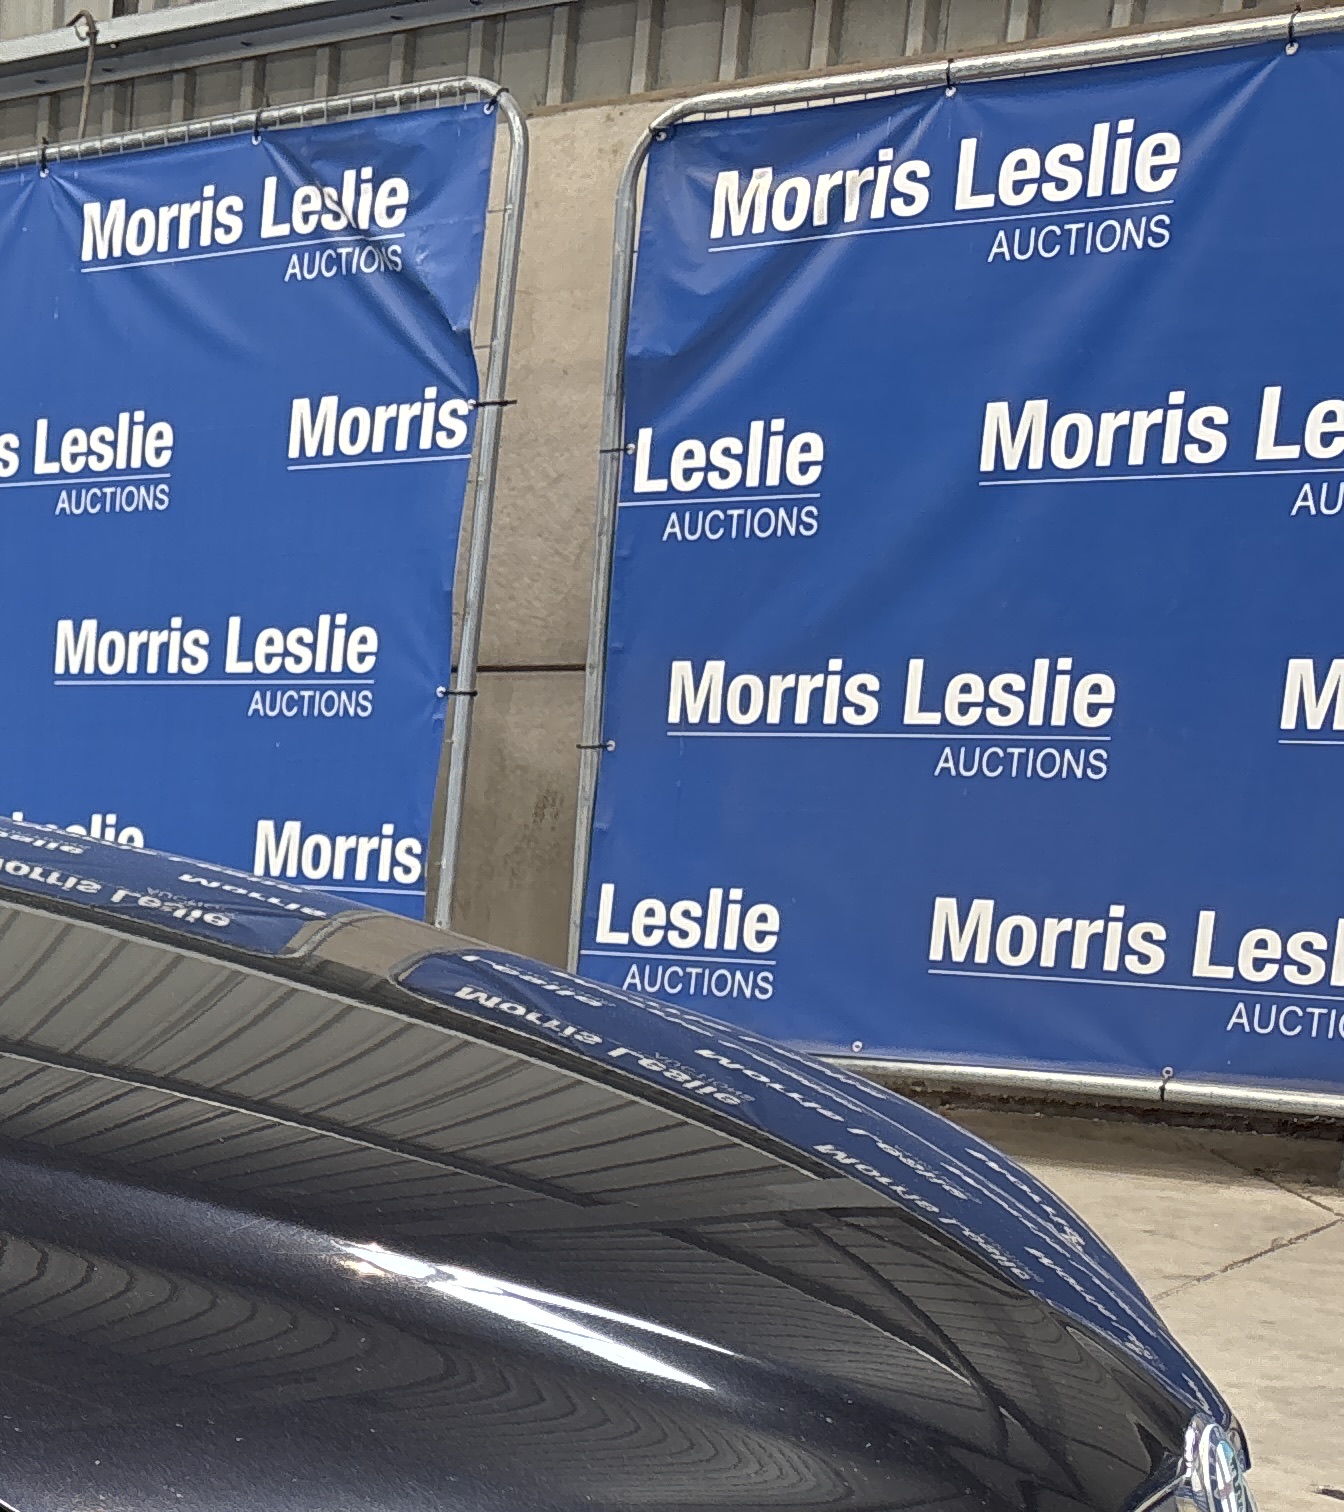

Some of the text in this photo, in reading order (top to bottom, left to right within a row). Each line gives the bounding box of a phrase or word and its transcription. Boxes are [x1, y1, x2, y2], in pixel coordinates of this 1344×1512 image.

[710, 118, 1181, 239] Morris Leslie
[81, 166, 410, 262] Morris Leslie
[987, 214, 1171, 263] AUCTIONS
[284, 244, 402, 282] AUCTIONS
[33, 410, 174, 475] Leslie
[287, 386, 470, 460] Morris
[632, 417, 825, 494] Leslie
[979, 390, 1229, 472] Morris
[54, 483, 170, 516] AUCTIONS
[662, 505, 818, 541] AUCTIONS
[54, 613, 378, 675] Morris Leslie
[247, 689, 373, 718] AUCTIONS
[667, 657, 1116, 728] Morris Leslie
[934, 746, 1108, 780] AUCTIONS
[253, 819, 423, 884] Morris
[595, 883, 780, 953] Leslie
[928, 896, 1344, 987] Morris Lesl
[622, 962, 775, 1000] AUCTIONS
[1226, 1002, 1344, 1039] AUCTI
